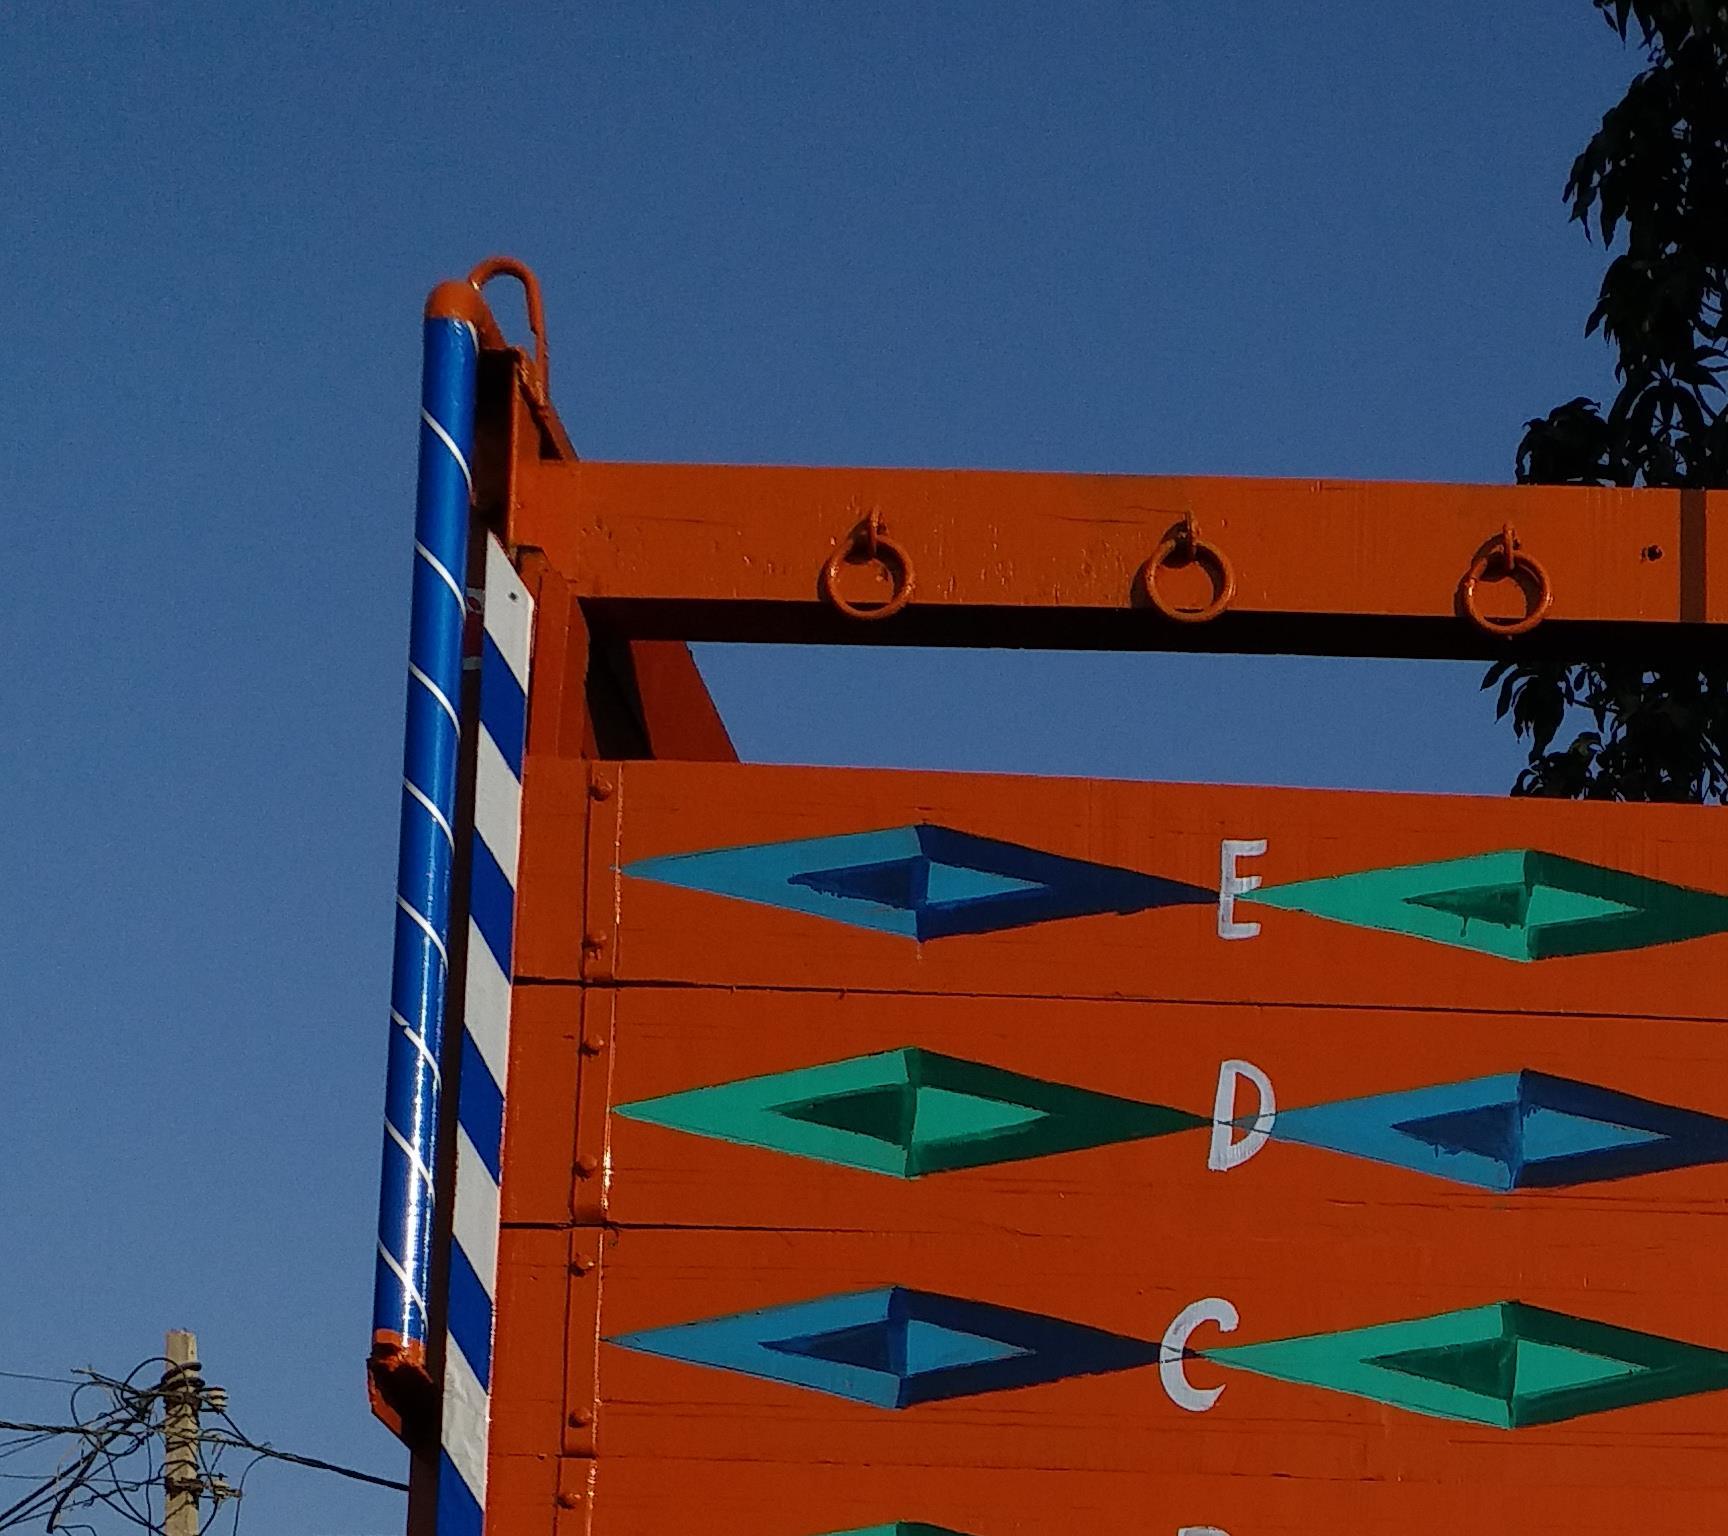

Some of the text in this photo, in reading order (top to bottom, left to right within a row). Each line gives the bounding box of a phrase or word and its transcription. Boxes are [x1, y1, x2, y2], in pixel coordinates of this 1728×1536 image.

[1217, 840, 1268, 940] E
[1209, 1060, 1275, 1171] D
[1159, 1297, 1239, 1411] C
